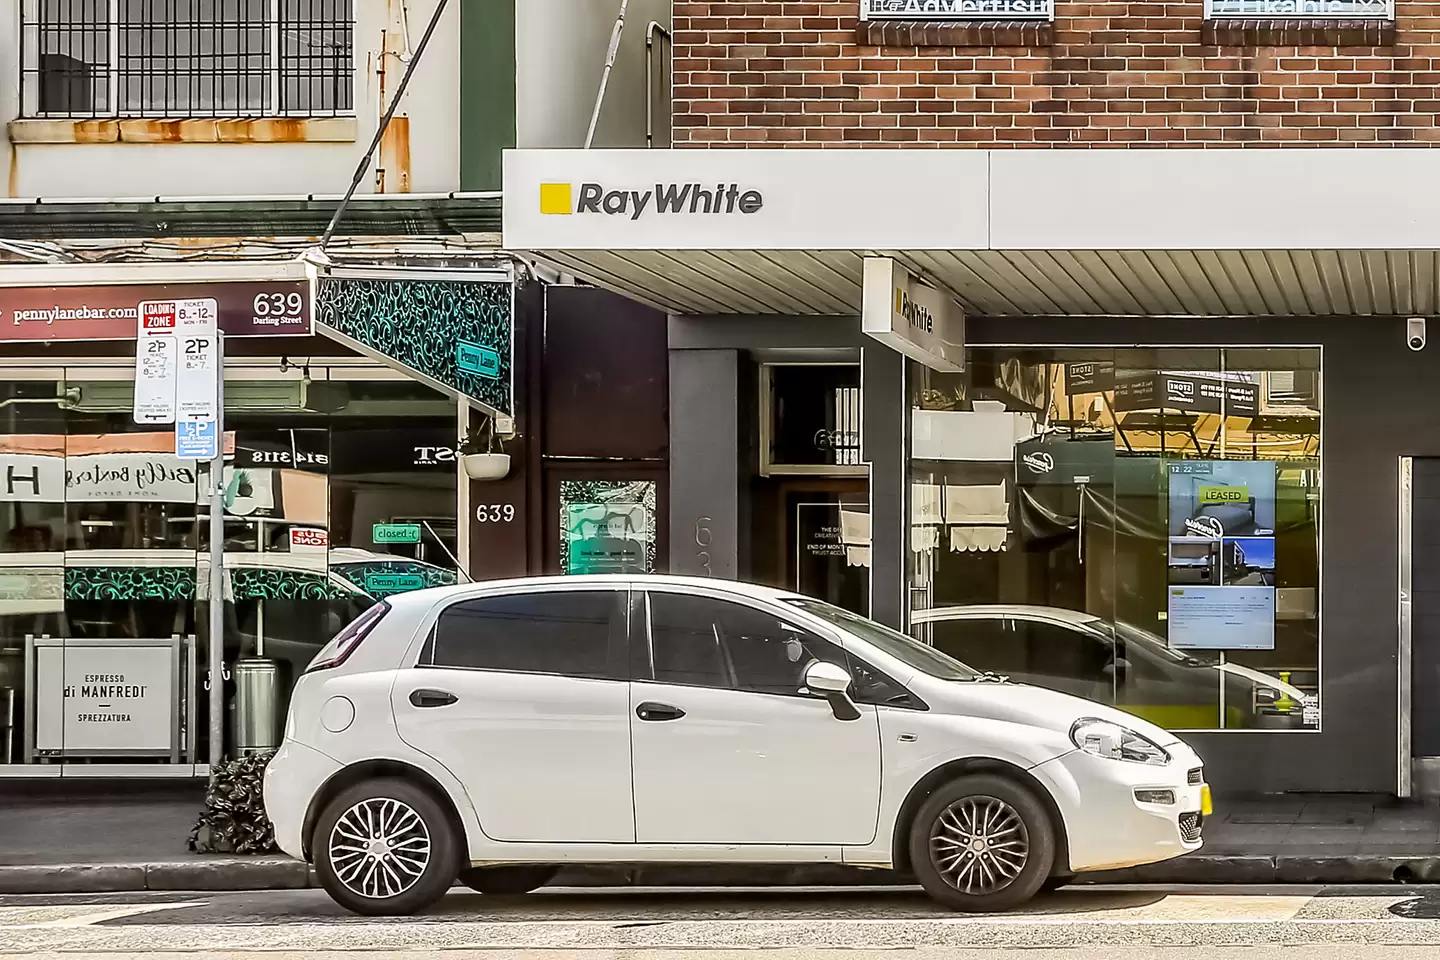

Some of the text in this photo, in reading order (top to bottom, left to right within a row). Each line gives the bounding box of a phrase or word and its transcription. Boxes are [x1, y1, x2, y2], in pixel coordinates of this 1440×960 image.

[144, 303, 175, 315] LOADING
[253, 292, 302, 316] 639
[13, 307, 138, 324] pennylanebar.com
[147, 316, 171, 327] ZONE
[253, 316, 302, 326] Darling Street
[148, 340, 166, 352] 2P
[185, 338, 209, 353] 2P
[1205, 491, 1242, 500] LEASED
[476, 504, 515, 522] 639
[378, 529, 407, 538] closed
[85, 674, 125, 683] ESPRESSO
[64, 686, 76, 698] di
[78, 714, 131, 722] SPREZZATURA
